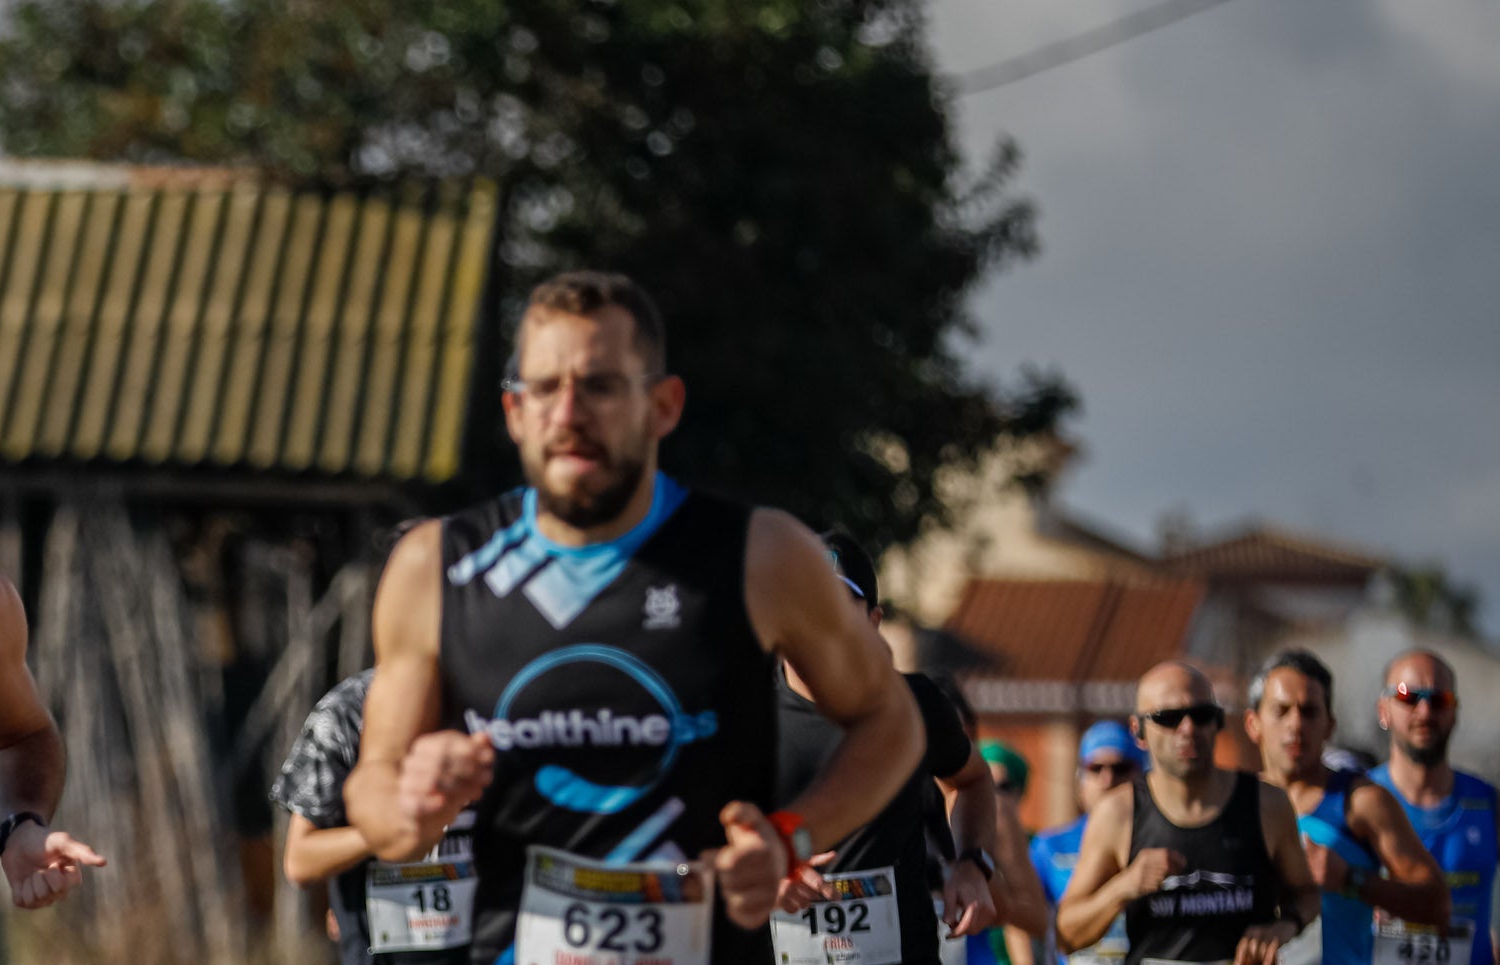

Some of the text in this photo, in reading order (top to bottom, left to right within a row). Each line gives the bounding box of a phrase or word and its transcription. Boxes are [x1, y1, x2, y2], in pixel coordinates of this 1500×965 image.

[411, 884, 451, 912] 18
[564, 902, 664, 953] 623
[802, 901, 871, 935] 192
